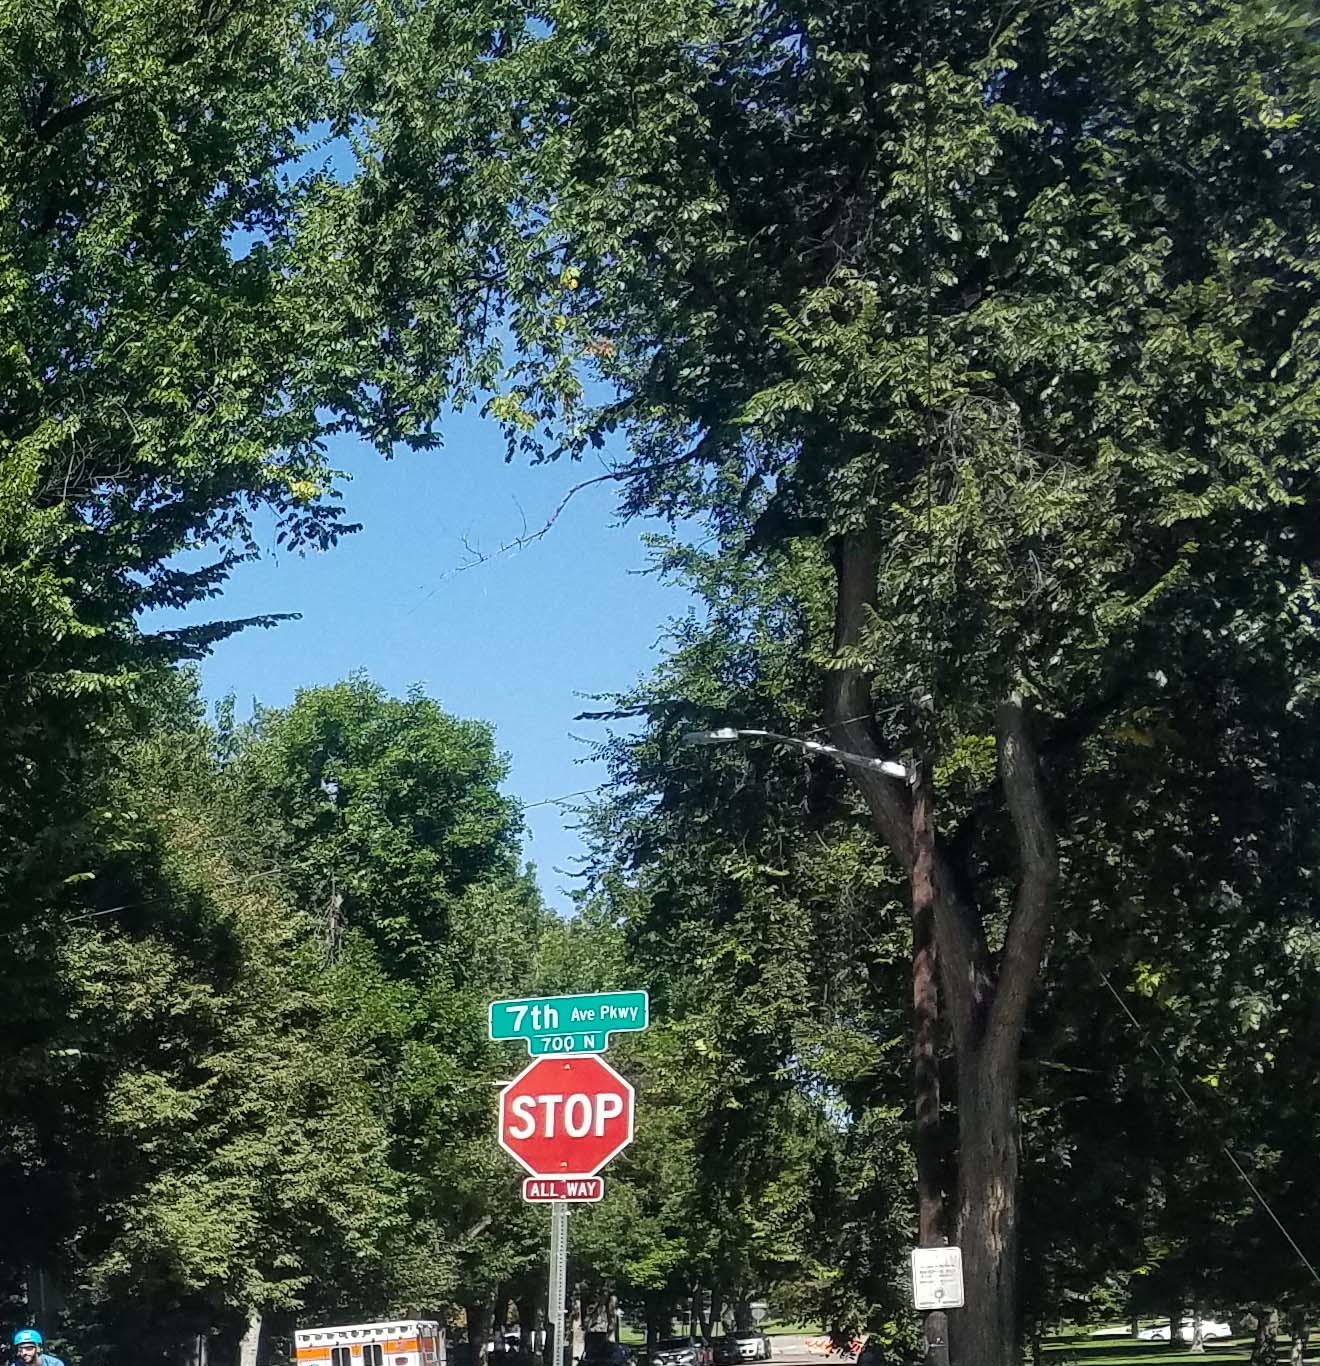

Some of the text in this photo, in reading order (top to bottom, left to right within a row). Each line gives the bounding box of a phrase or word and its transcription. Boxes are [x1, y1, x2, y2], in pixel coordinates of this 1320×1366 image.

[506, 1004, 638, 1031] 7th Ave Pkwy
[541, 1034, 595, 1052] 700 N
[508, 1093, 624, 1140] STOP
[530, 1181, 597, 1197] ALL WAY
